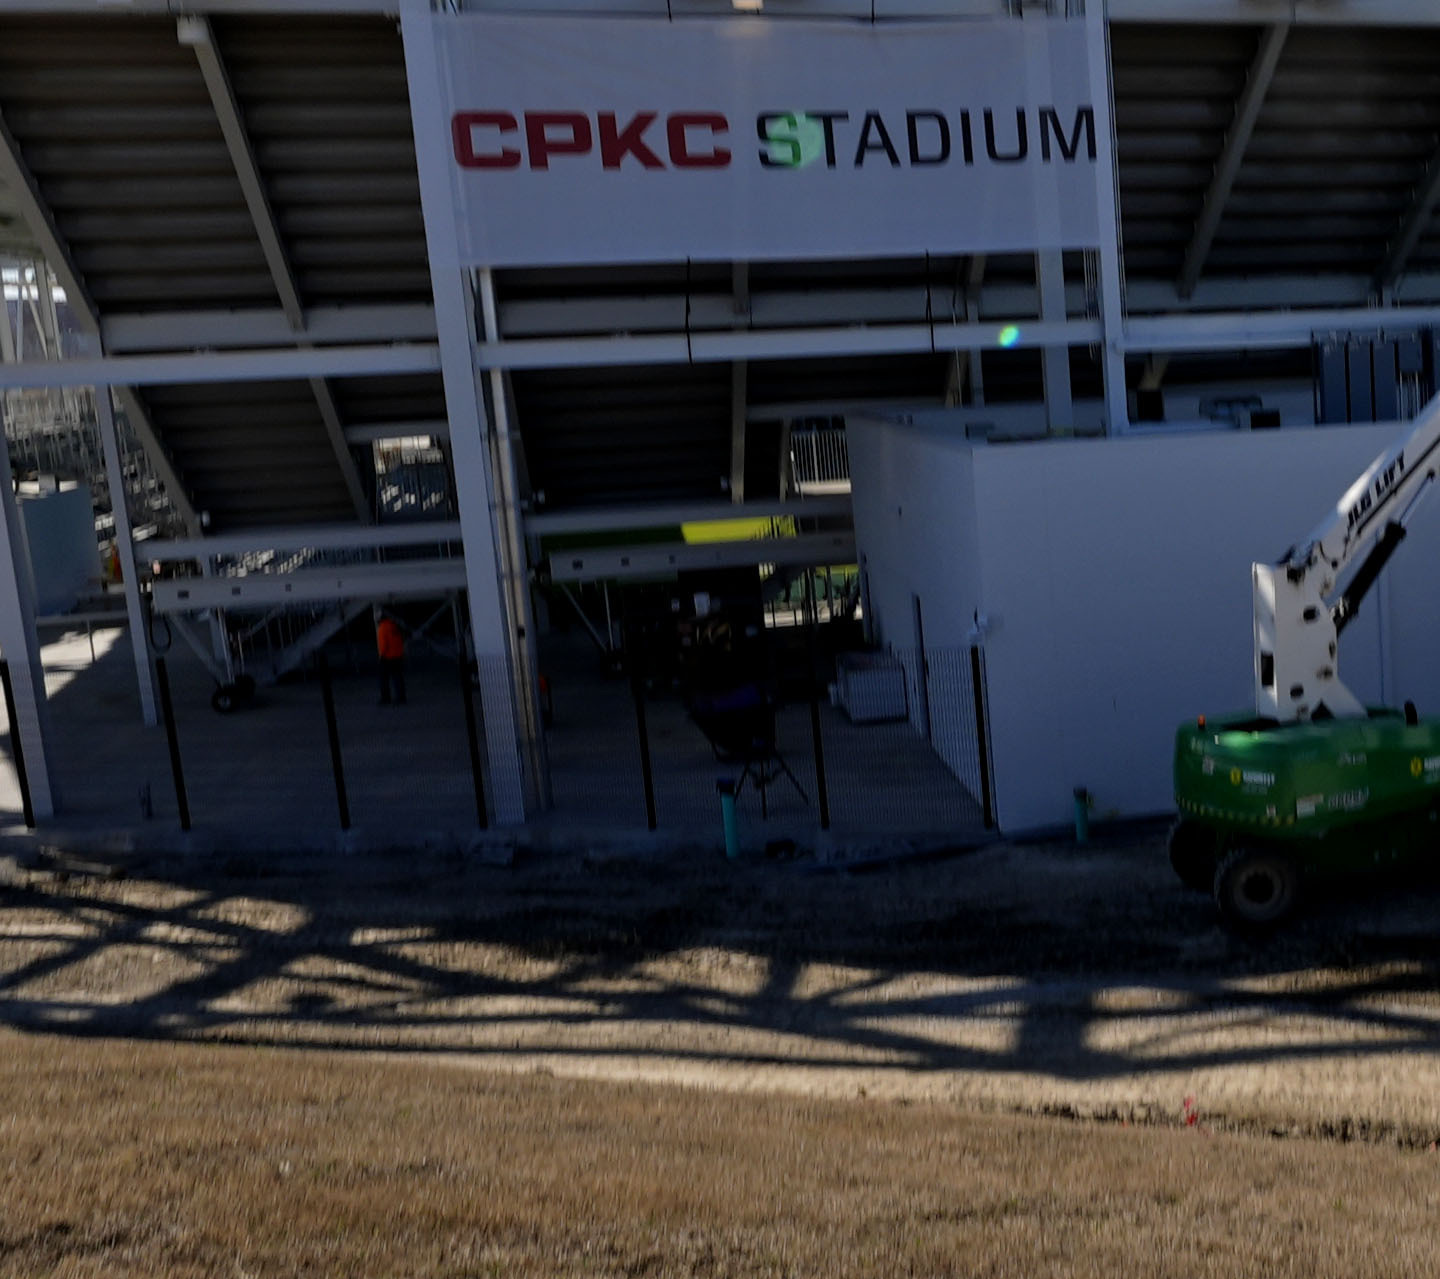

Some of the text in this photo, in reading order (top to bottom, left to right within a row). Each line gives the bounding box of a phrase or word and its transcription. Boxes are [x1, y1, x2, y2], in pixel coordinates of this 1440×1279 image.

[451, 106, 1098, 171] CPKC STADIUM
[1375, 448, 1404, 499] LIFT
